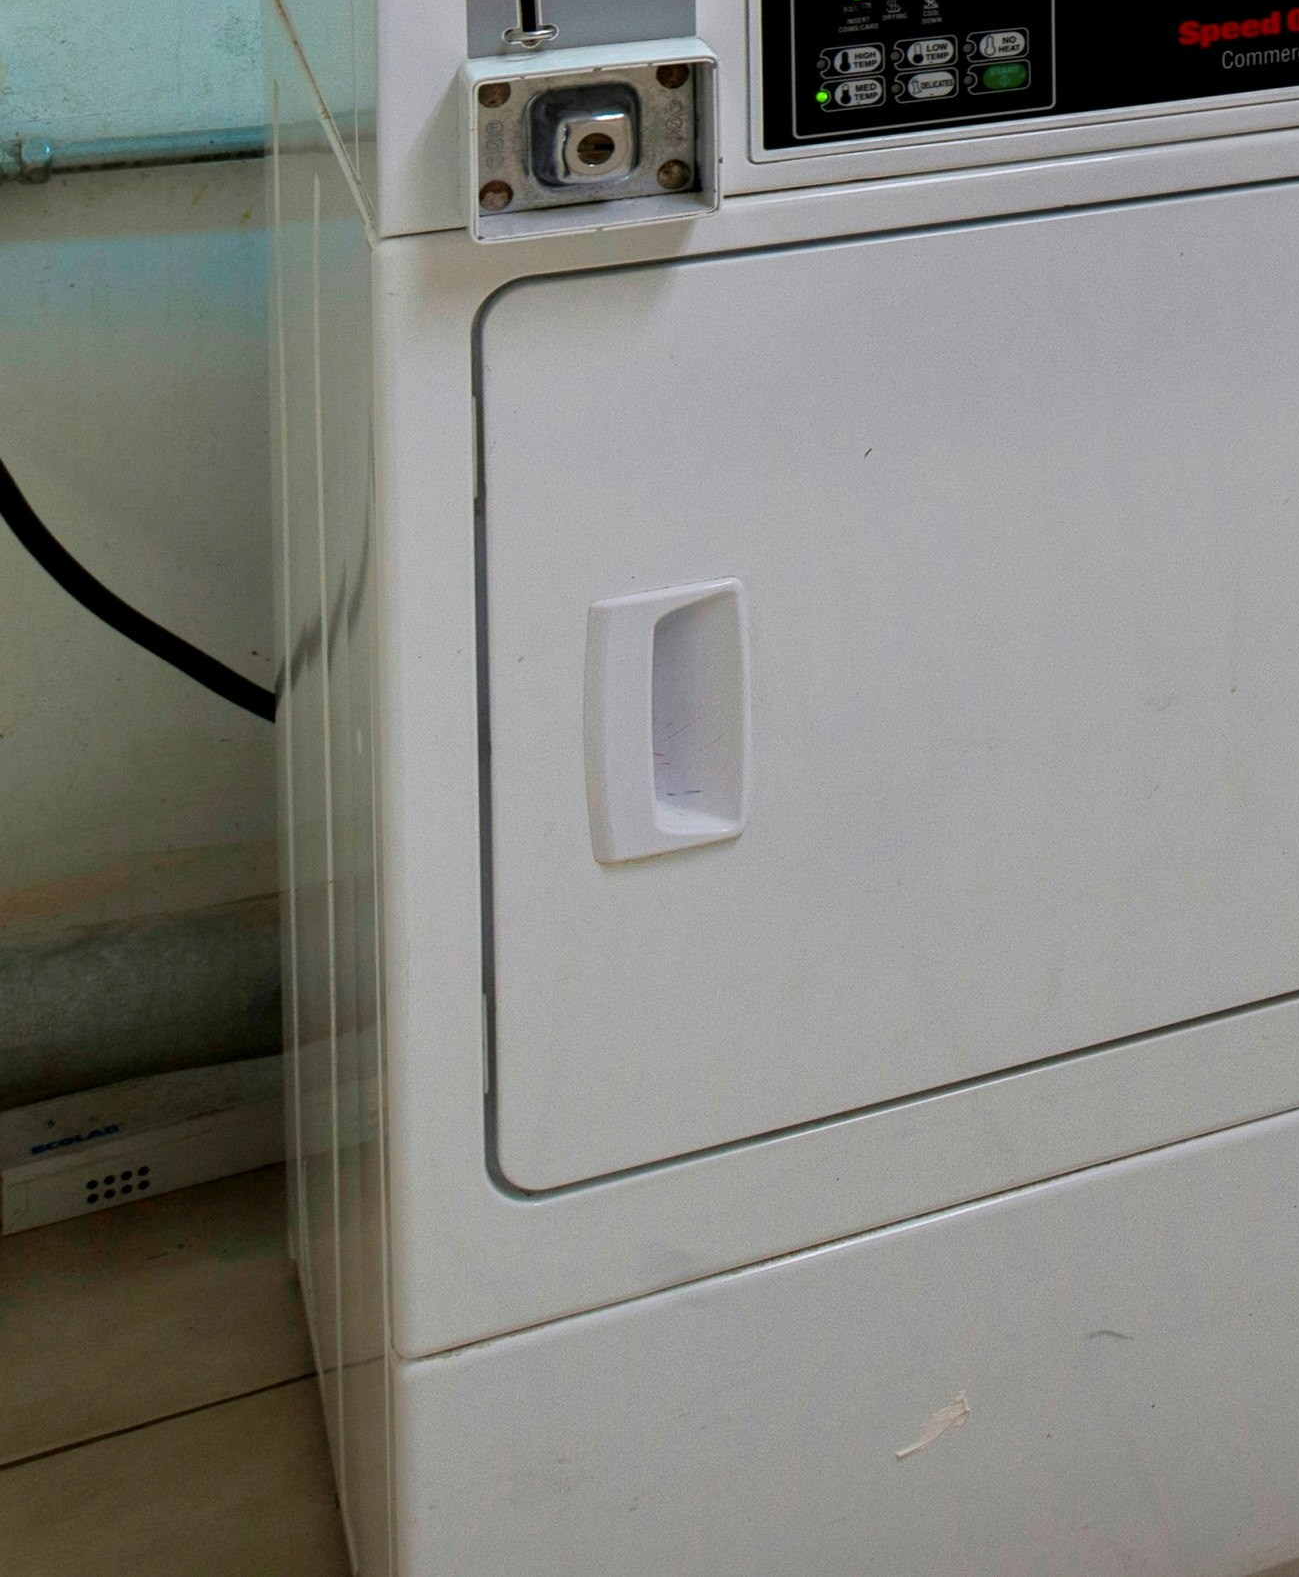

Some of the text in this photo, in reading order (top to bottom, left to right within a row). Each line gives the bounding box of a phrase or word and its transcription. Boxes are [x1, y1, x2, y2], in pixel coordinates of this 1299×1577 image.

[846, 16, 870, 25] INSERT
[882, 13, 908, 21] DRYING
[1178, 10, 1281, 48] Speed
[1002, 36, 1016, 44] NO
[926, 43, 947, 52] LOW
[998, 43, 1020, 53] HEAT
[854, 51, 877, 60] HIGH
[926, 51, 949, 61] TEMP
[854, 59, 878, 68] TEMP
[855, 83, 877, 92] MED
[921, 78, 953, 90] DELICATES
[854, 91, 878, 101] TEMP
[31, 1124, 119, 1154] ECOLAB
